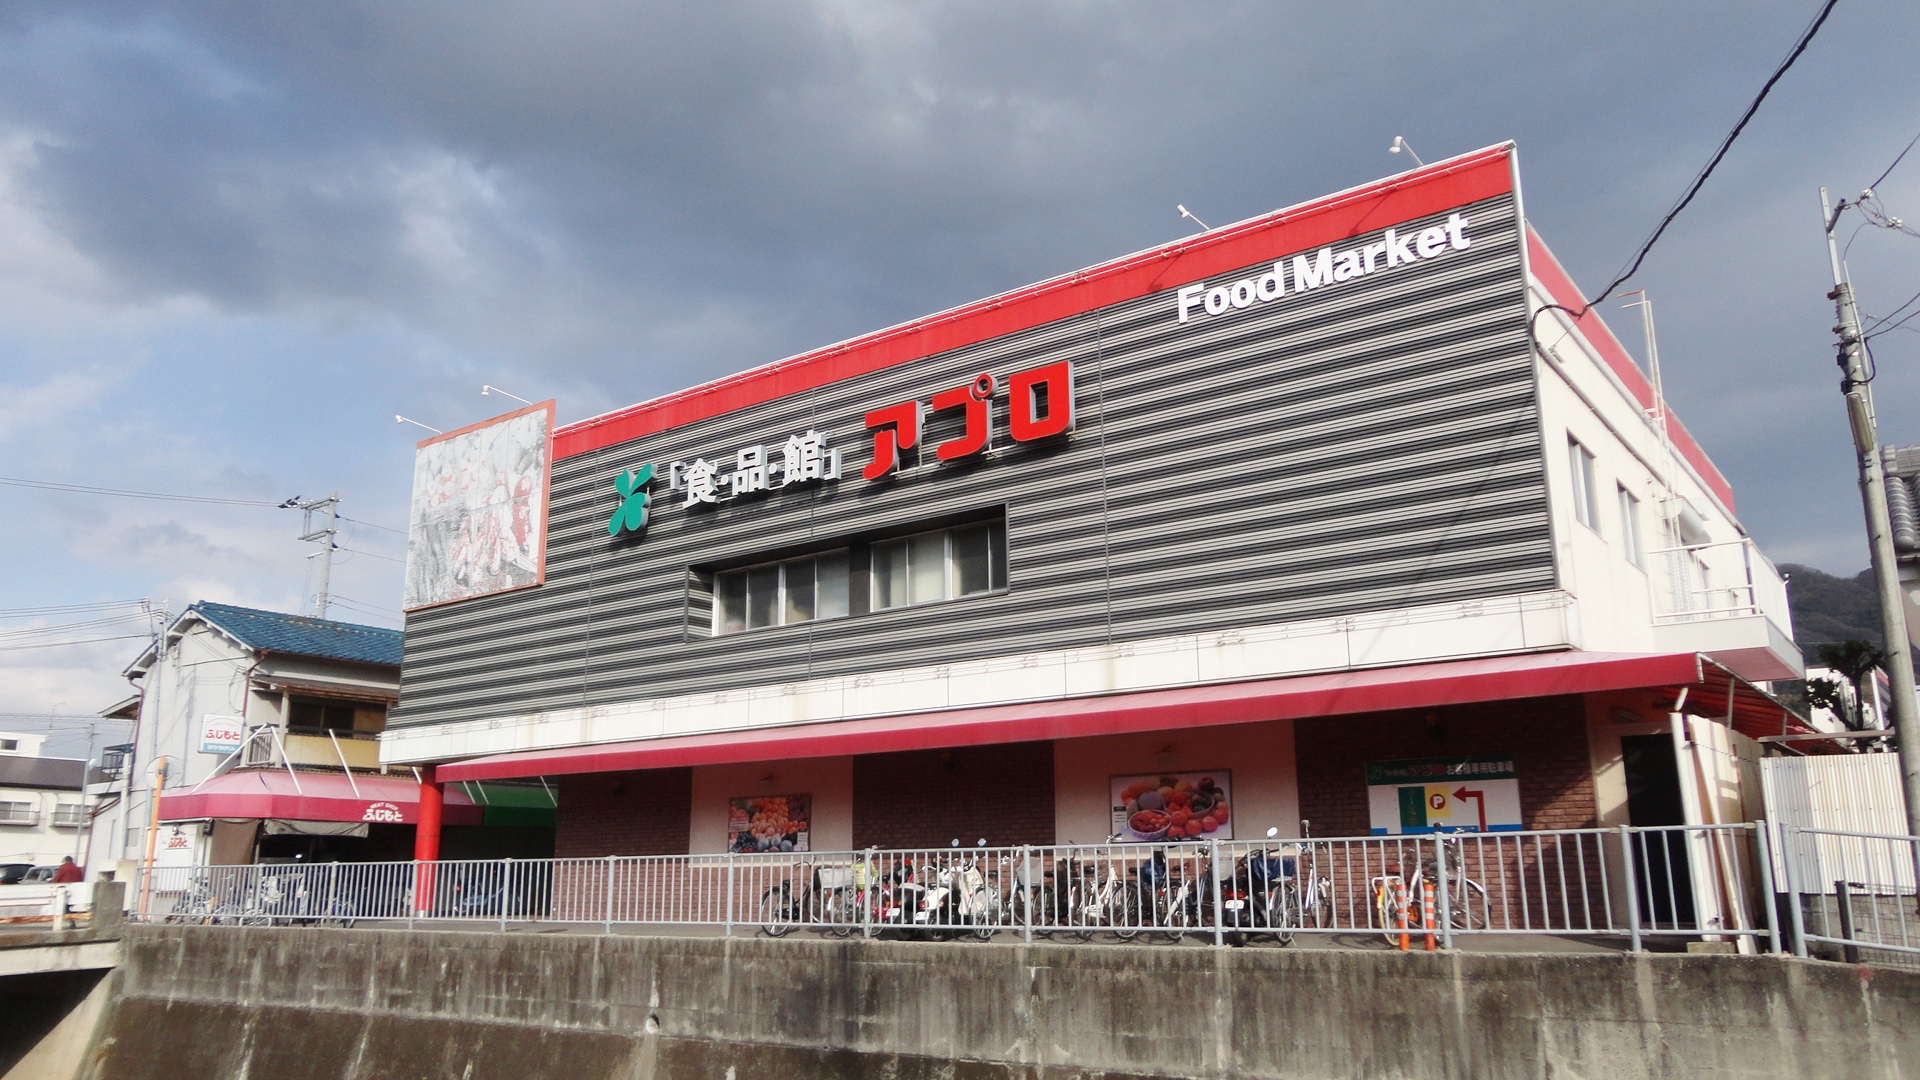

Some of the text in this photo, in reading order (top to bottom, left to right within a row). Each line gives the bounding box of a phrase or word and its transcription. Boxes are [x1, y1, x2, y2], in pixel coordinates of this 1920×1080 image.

[1177, 213, 1471, 323] Food Market
[862, 361, 1075, 480] アプロ
[205, 729, 240, 741] ふじもと
[362, 808, 403, 822] ふじもと
